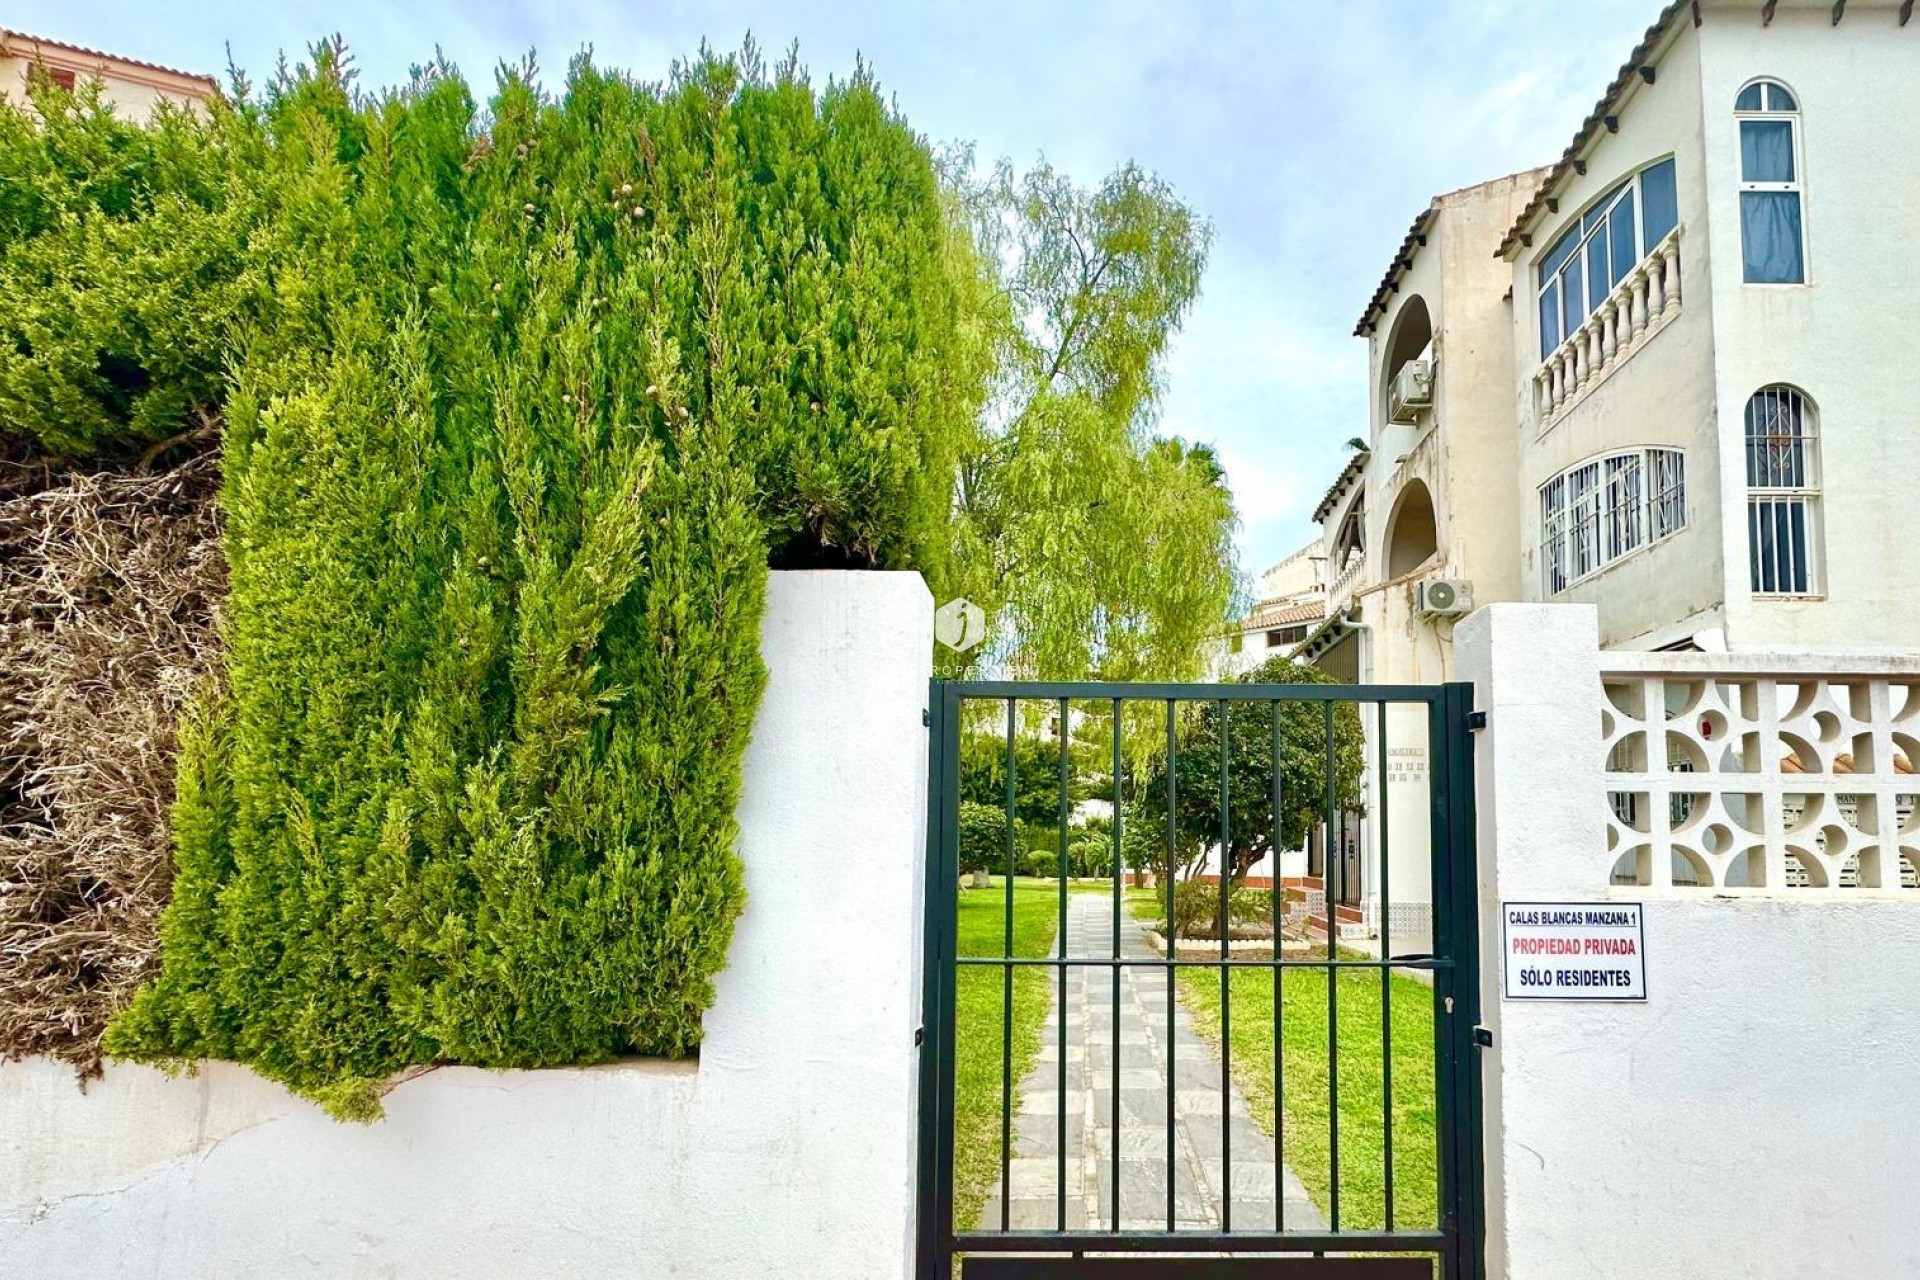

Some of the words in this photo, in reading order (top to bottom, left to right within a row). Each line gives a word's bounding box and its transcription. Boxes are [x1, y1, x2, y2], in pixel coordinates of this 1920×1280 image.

[1509, 911, 1539, 924] CALAS
[1541, 911, 1583, 925] BLANCAS
[1585, 912, 1629, 925] MANZANA
[1630, 912, 1636, 925] 1
[1512, 937, 1581, 955] PROPIEDAD
[1584, 938, 1636, 955] PRIVADA
[1520, 965, 1553, 987] SÓLO
[1556, 969, 1631, 987] RESIDENTES
